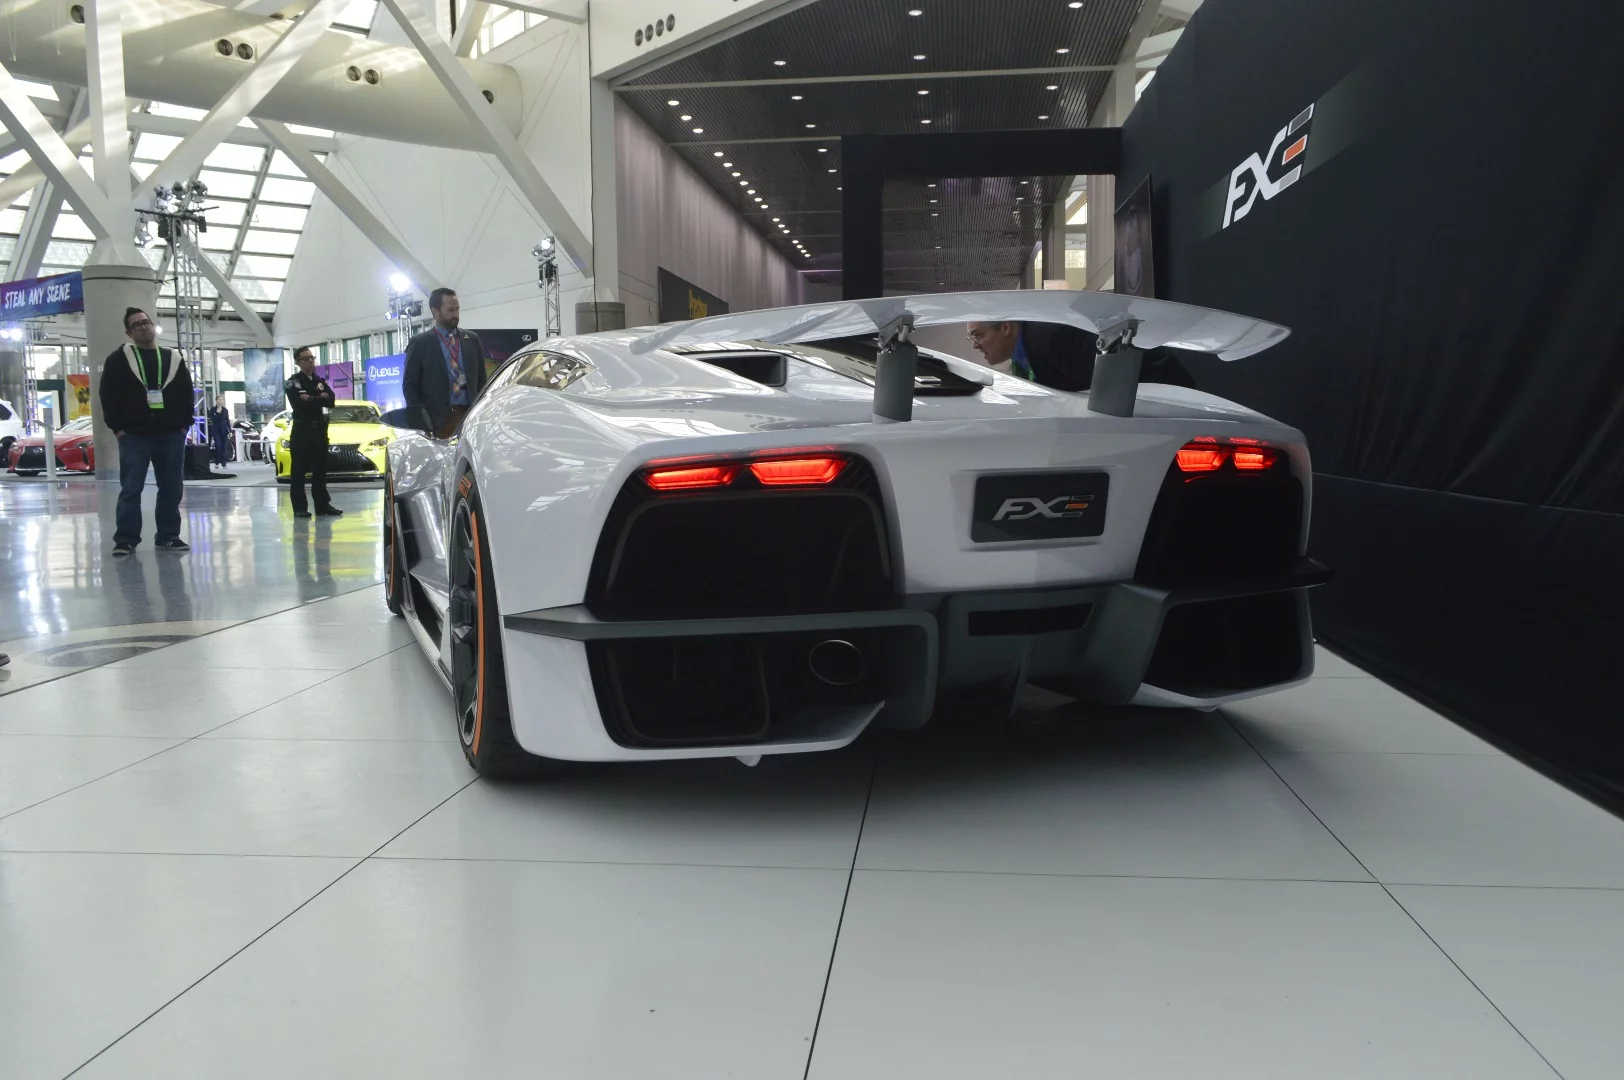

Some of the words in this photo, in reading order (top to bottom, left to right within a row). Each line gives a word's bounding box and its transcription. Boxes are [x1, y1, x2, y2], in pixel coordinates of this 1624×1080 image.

[5, 290, 25, 309] STEAL
[29, 287, 44, 305] ANY
[47, 283, 71, 303] SCENE
[376, 366, 400, 378] LEXUS
